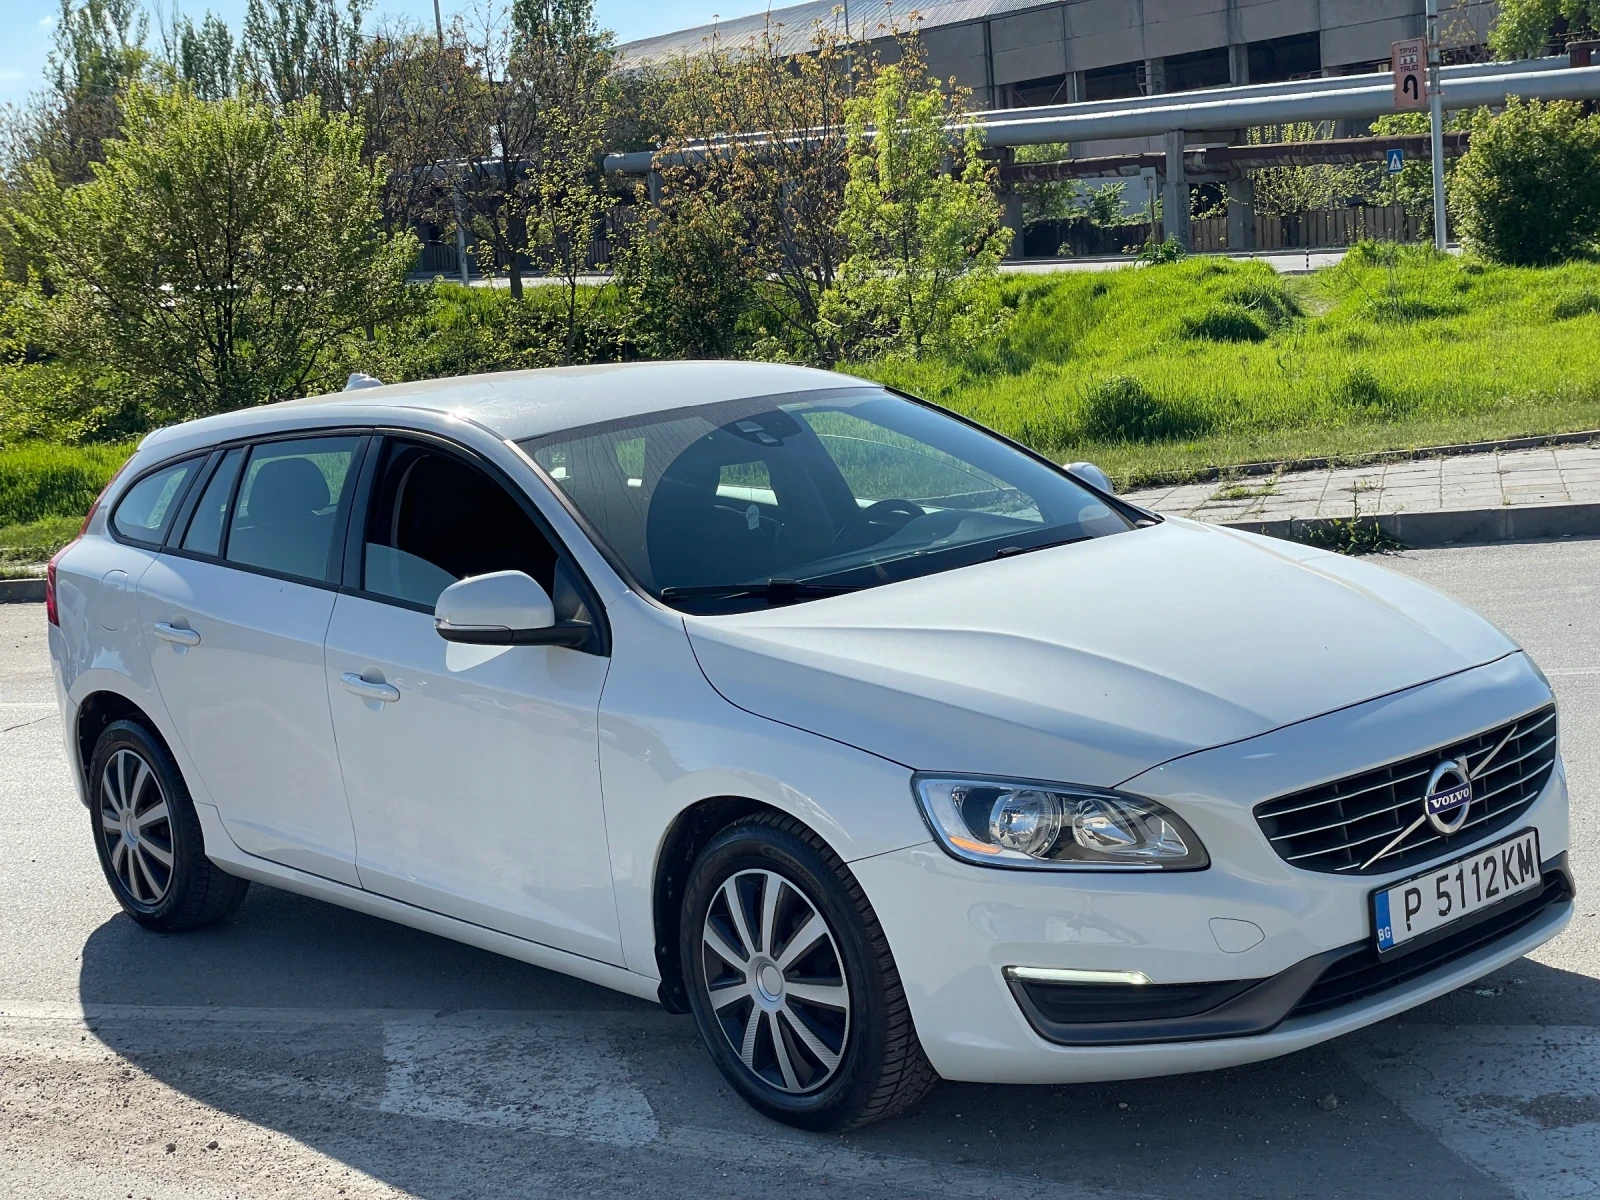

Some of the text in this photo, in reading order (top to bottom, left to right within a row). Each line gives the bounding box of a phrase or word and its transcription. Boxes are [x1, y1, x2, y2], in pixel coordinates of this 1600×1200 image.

[1400, 46, 1417, 54] ТРУД
[1430, 788, 1469, 808] VOLVO
[1404, 838, 1535, 932] P 5112KM
[1377, 926, 1391, 942] BG
